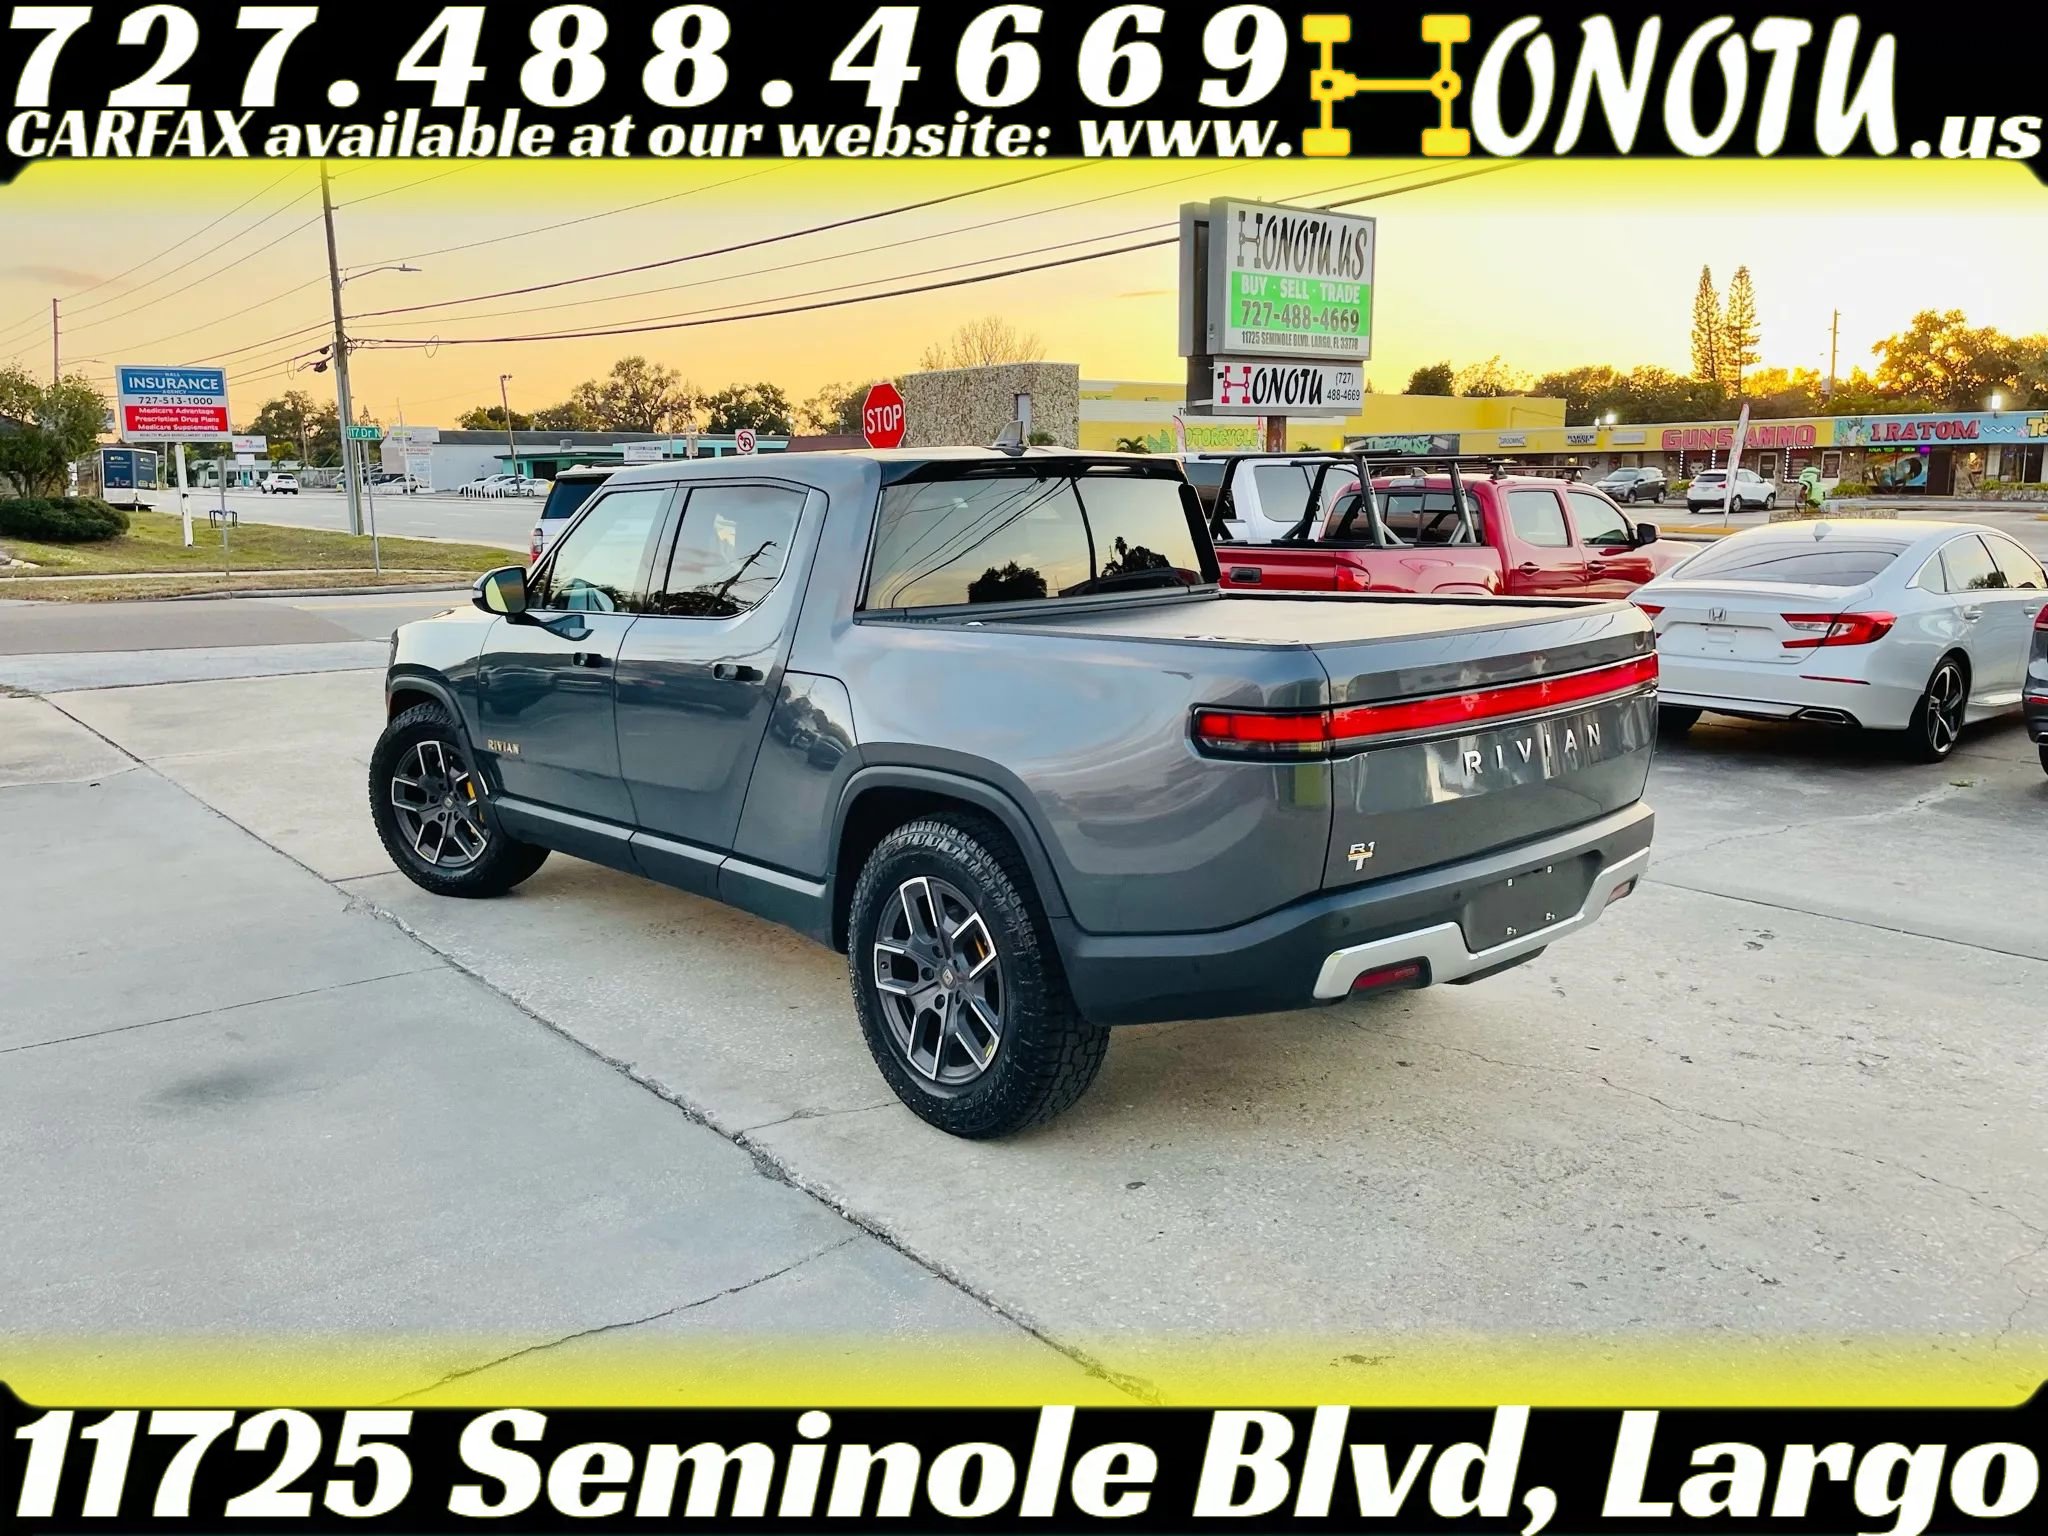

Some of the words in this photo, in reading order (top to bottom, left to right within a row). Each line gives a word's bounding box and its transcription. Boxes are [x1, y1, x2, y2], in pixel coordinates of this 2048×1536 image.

[1241, 274, 1268, 296] BUY
[1280, 278, 1310, 300] SELL
[1319, 282, 1361, 304] TRADE
[1241, 300, 1360, 333] 727-488-4669
[1261, 331, 1292, 347] SEMINOLE
[129, 377, 219, 390] INSURANCE
[1335, 372, 1354, 385] (727)
[138, 396, 213, 405] 727-513-1000
[1327, 389, 1361, 401] 488-4669
[134, 415, 179, 423] Prescription
[866, 404, 902, 435] STOP
[361, 428, 372, 438] Dr
[1661, 427, 1735, 450] GUNS
[1746, 424, 1817, 449] AMMO
[487, 739, 520, 755] RIVIAN
[1463, 722, 1601, 777] RIVIAN
